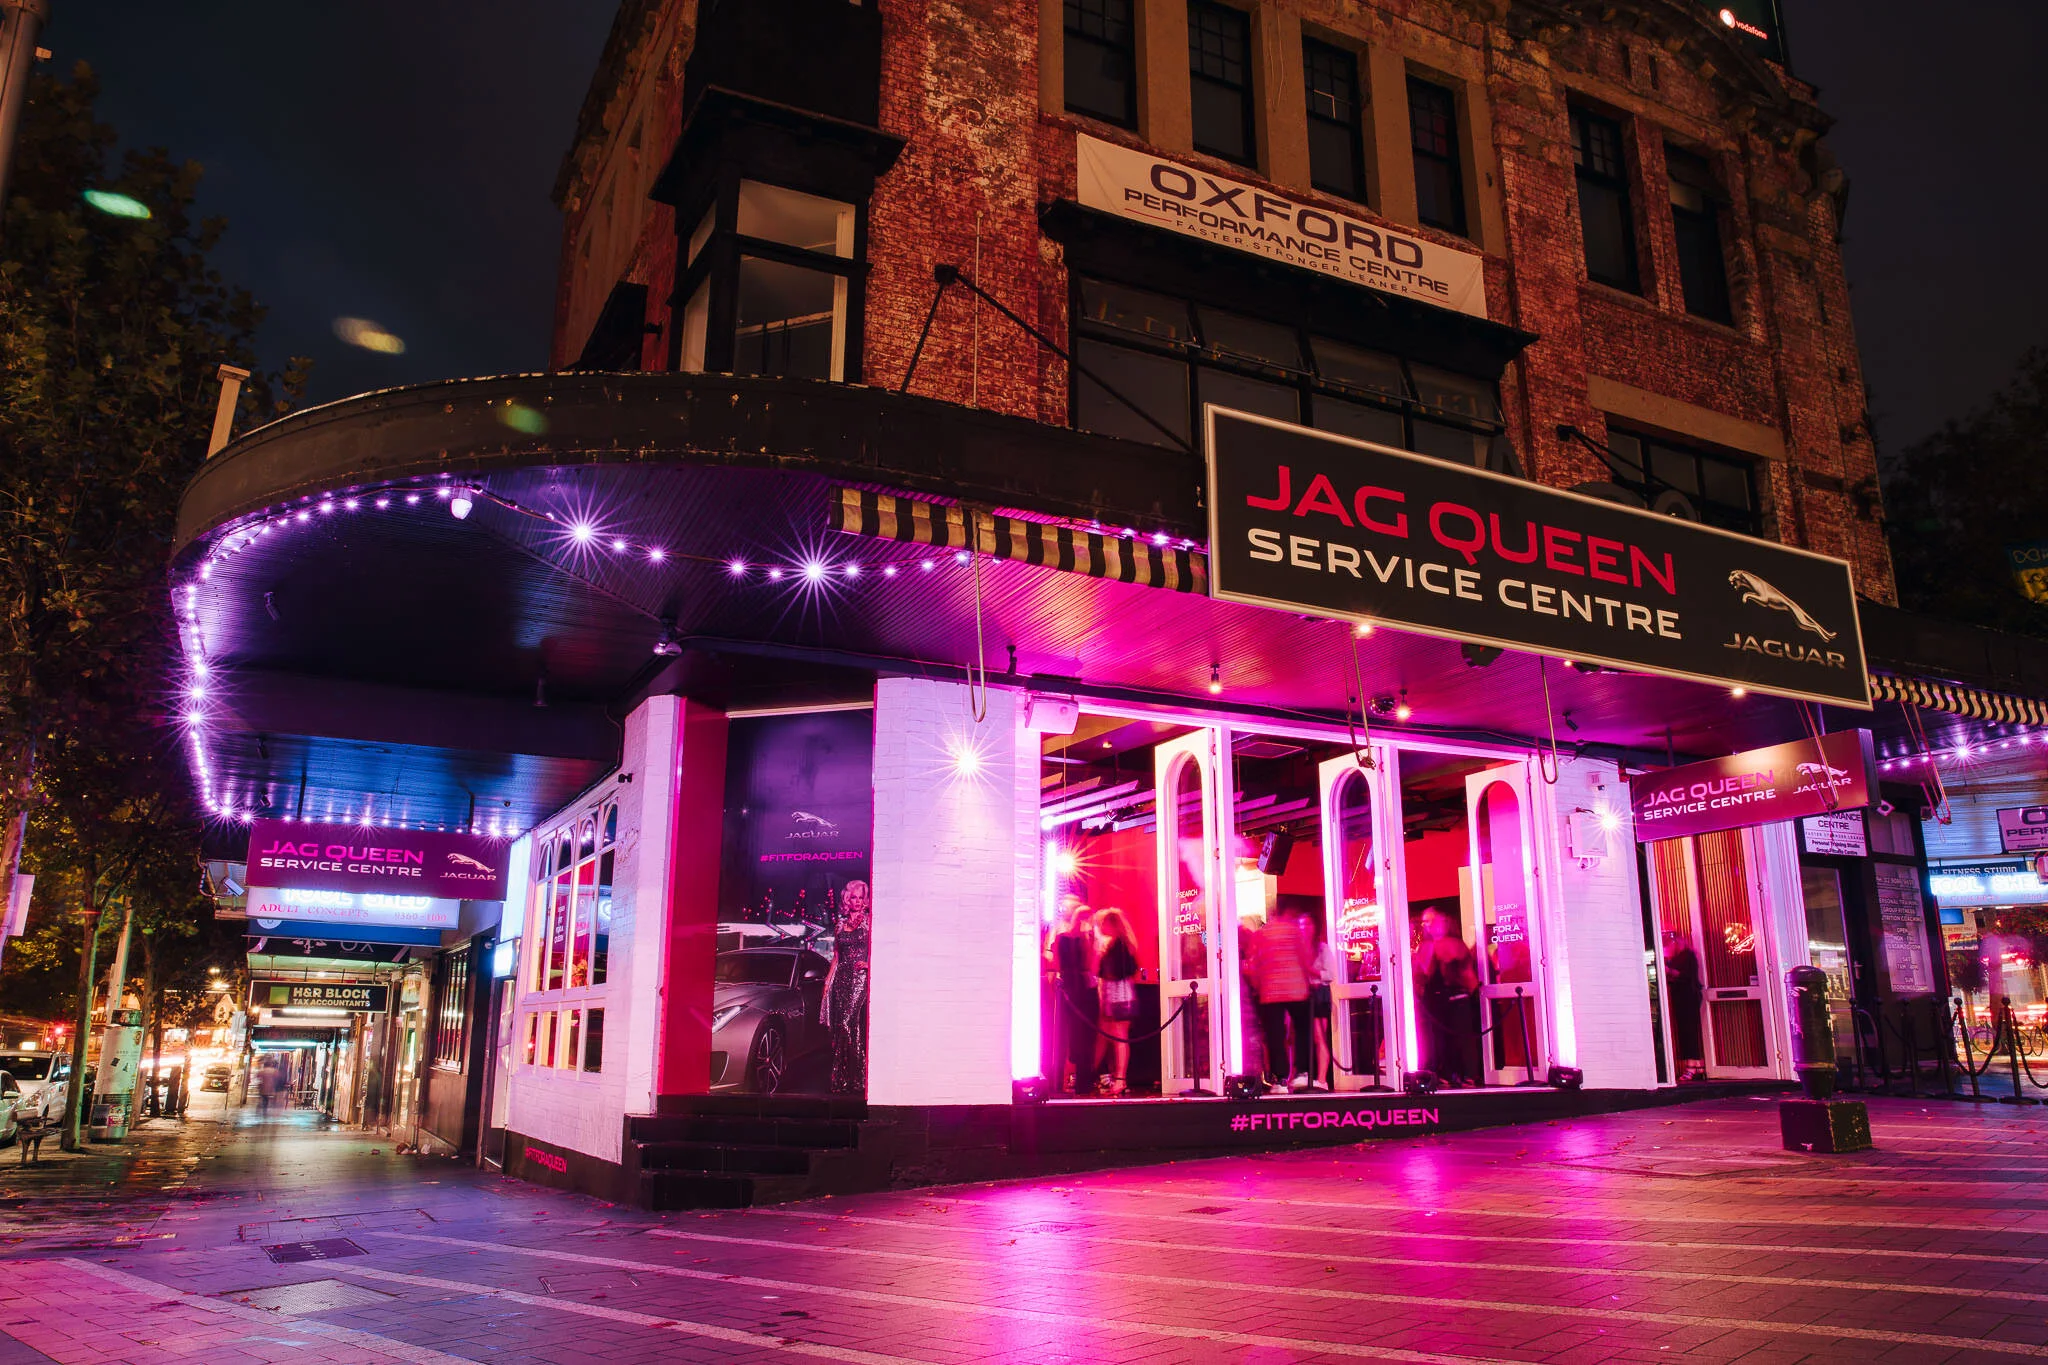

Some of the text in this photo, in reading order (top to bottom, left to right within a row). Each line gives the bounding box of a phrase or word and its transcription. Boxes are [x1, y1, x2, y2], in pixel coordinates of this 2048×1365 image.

[1736, 21, 1767, 39] vodafone
[1150, 163, 1424, 269] OXFORD
[1124, 187, 1449, 296] PERFORMANCE CENTRE
[1247, 465, 1677, 596] JAG QUEEN
[1247, 528, 1682, 640] SERVICE CENTRE
[1723, 632, 1846, 670] JAGUAR
[1643, 769, 1774, 808] JAG QUEEN
[1643, 788, 1777, 821] SERVICE CENTRE
[785, 830, 839, 839] JAGUAR
[262, 840, 424, 865] JAG QUEEN
[760, 851, 863, 862] #FITFORAQUEEN
[260, 857, 422, 877] SERVICE CENTRE
[440, 872, 497, 881] JAGUAR
[259, 903, 299, 913] ADULT
[307, 906, 369, 918] CONCEPTS
[1180, 902, 1193, 912] FIT
[1175, 912, 1199, 923] FOR A
[1499, 915, 1512, 923] FIT
[1173, 924, 1201, 935] QUEEN
[1343, 930, 1374, 942] QUEEN
[1493, 925, 1512, 933] FOR
[1491, 933, 1523, 943] QUEEN
[293, 987, 370, 999] H&R BLOCK
[310, 999, 371, 1007] ACCOUNTANTS
[1230, 1108, 1439, 1132] #FITFORAQUEEN
[525, 1146, 568, 1174] #FITFORAQUEEN
